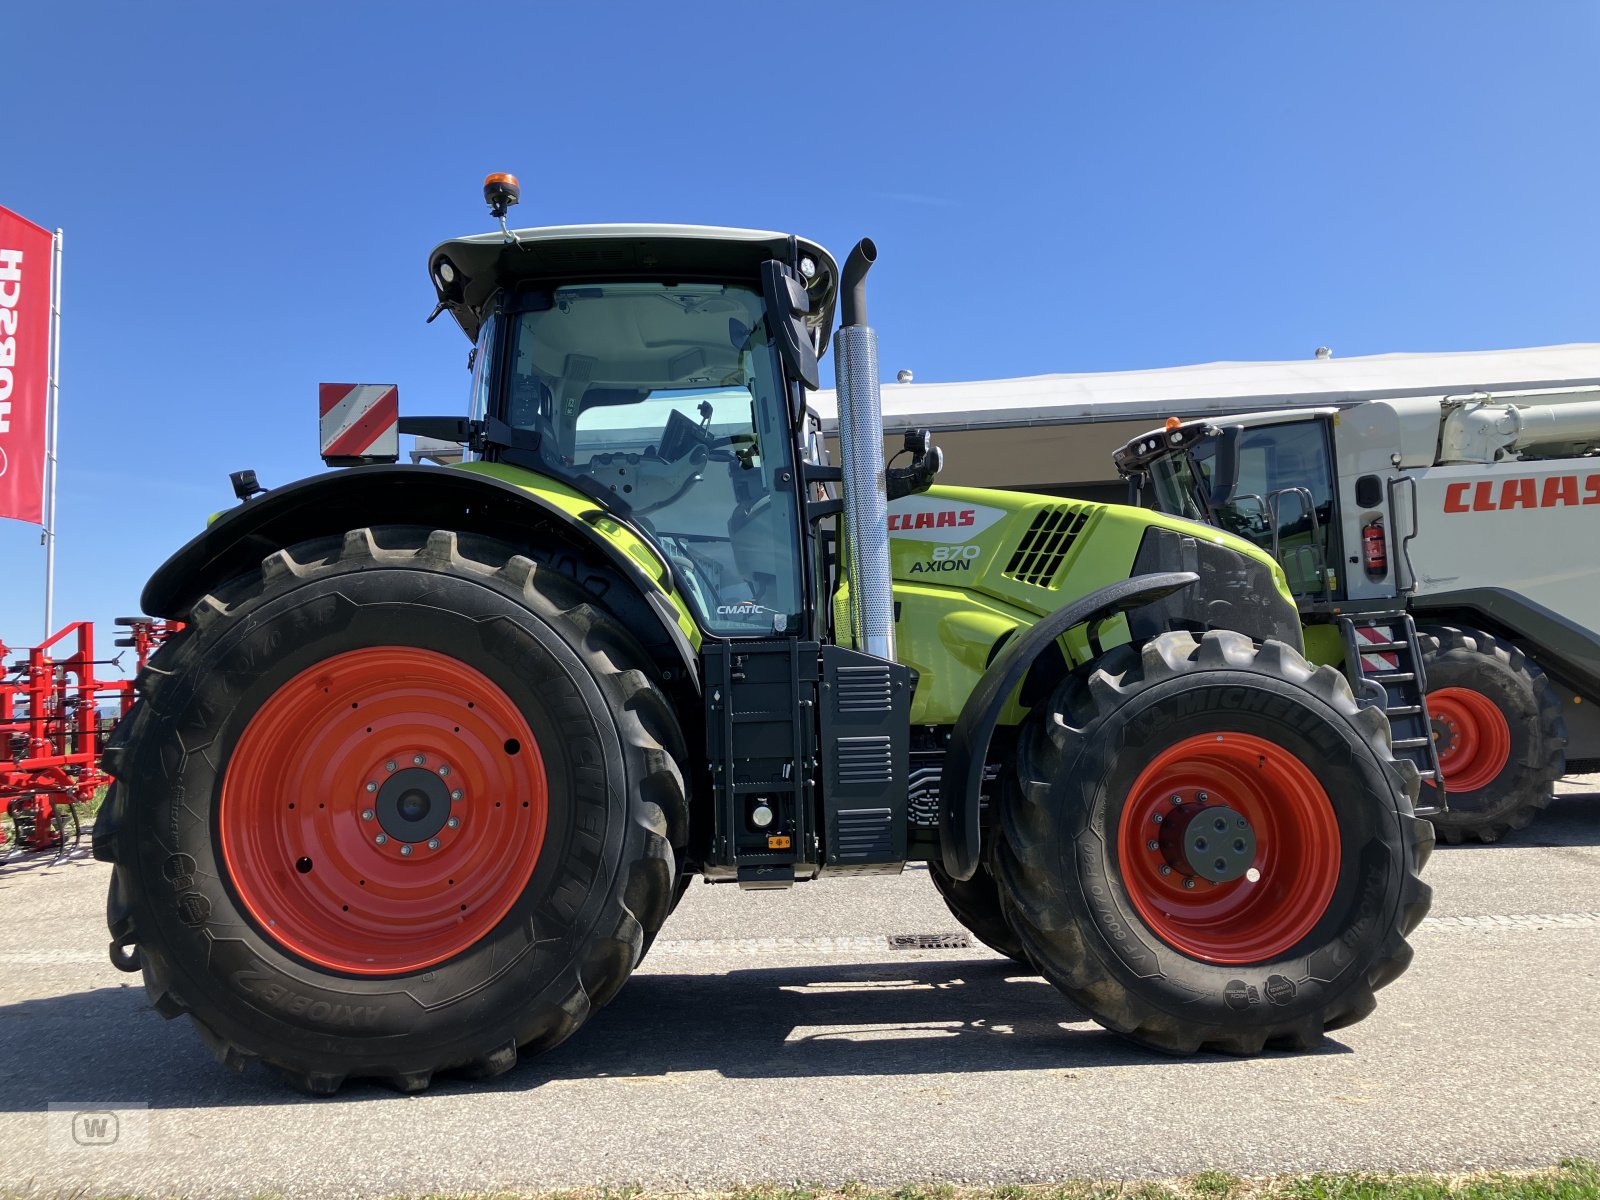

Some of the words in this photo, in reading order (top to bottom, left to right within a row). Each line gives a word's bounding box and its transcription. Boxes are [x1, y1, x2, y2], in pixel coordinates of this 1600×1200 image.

[1444, 474, 1600, 513] CLAAS
[888, 510, 975, 530] CLAAS
[909, 560, 971, 573] AXION
[932, 545, 980, 560] 870
[716, 605, 763, 614] CMATIC
[1176, 686, 1344, 758] MICHELIN
[1088, 884, 1128, 943] 600/70
[229, 959, 276, 991] 2
[263, 984, 386, 1026] AXIOBIB
